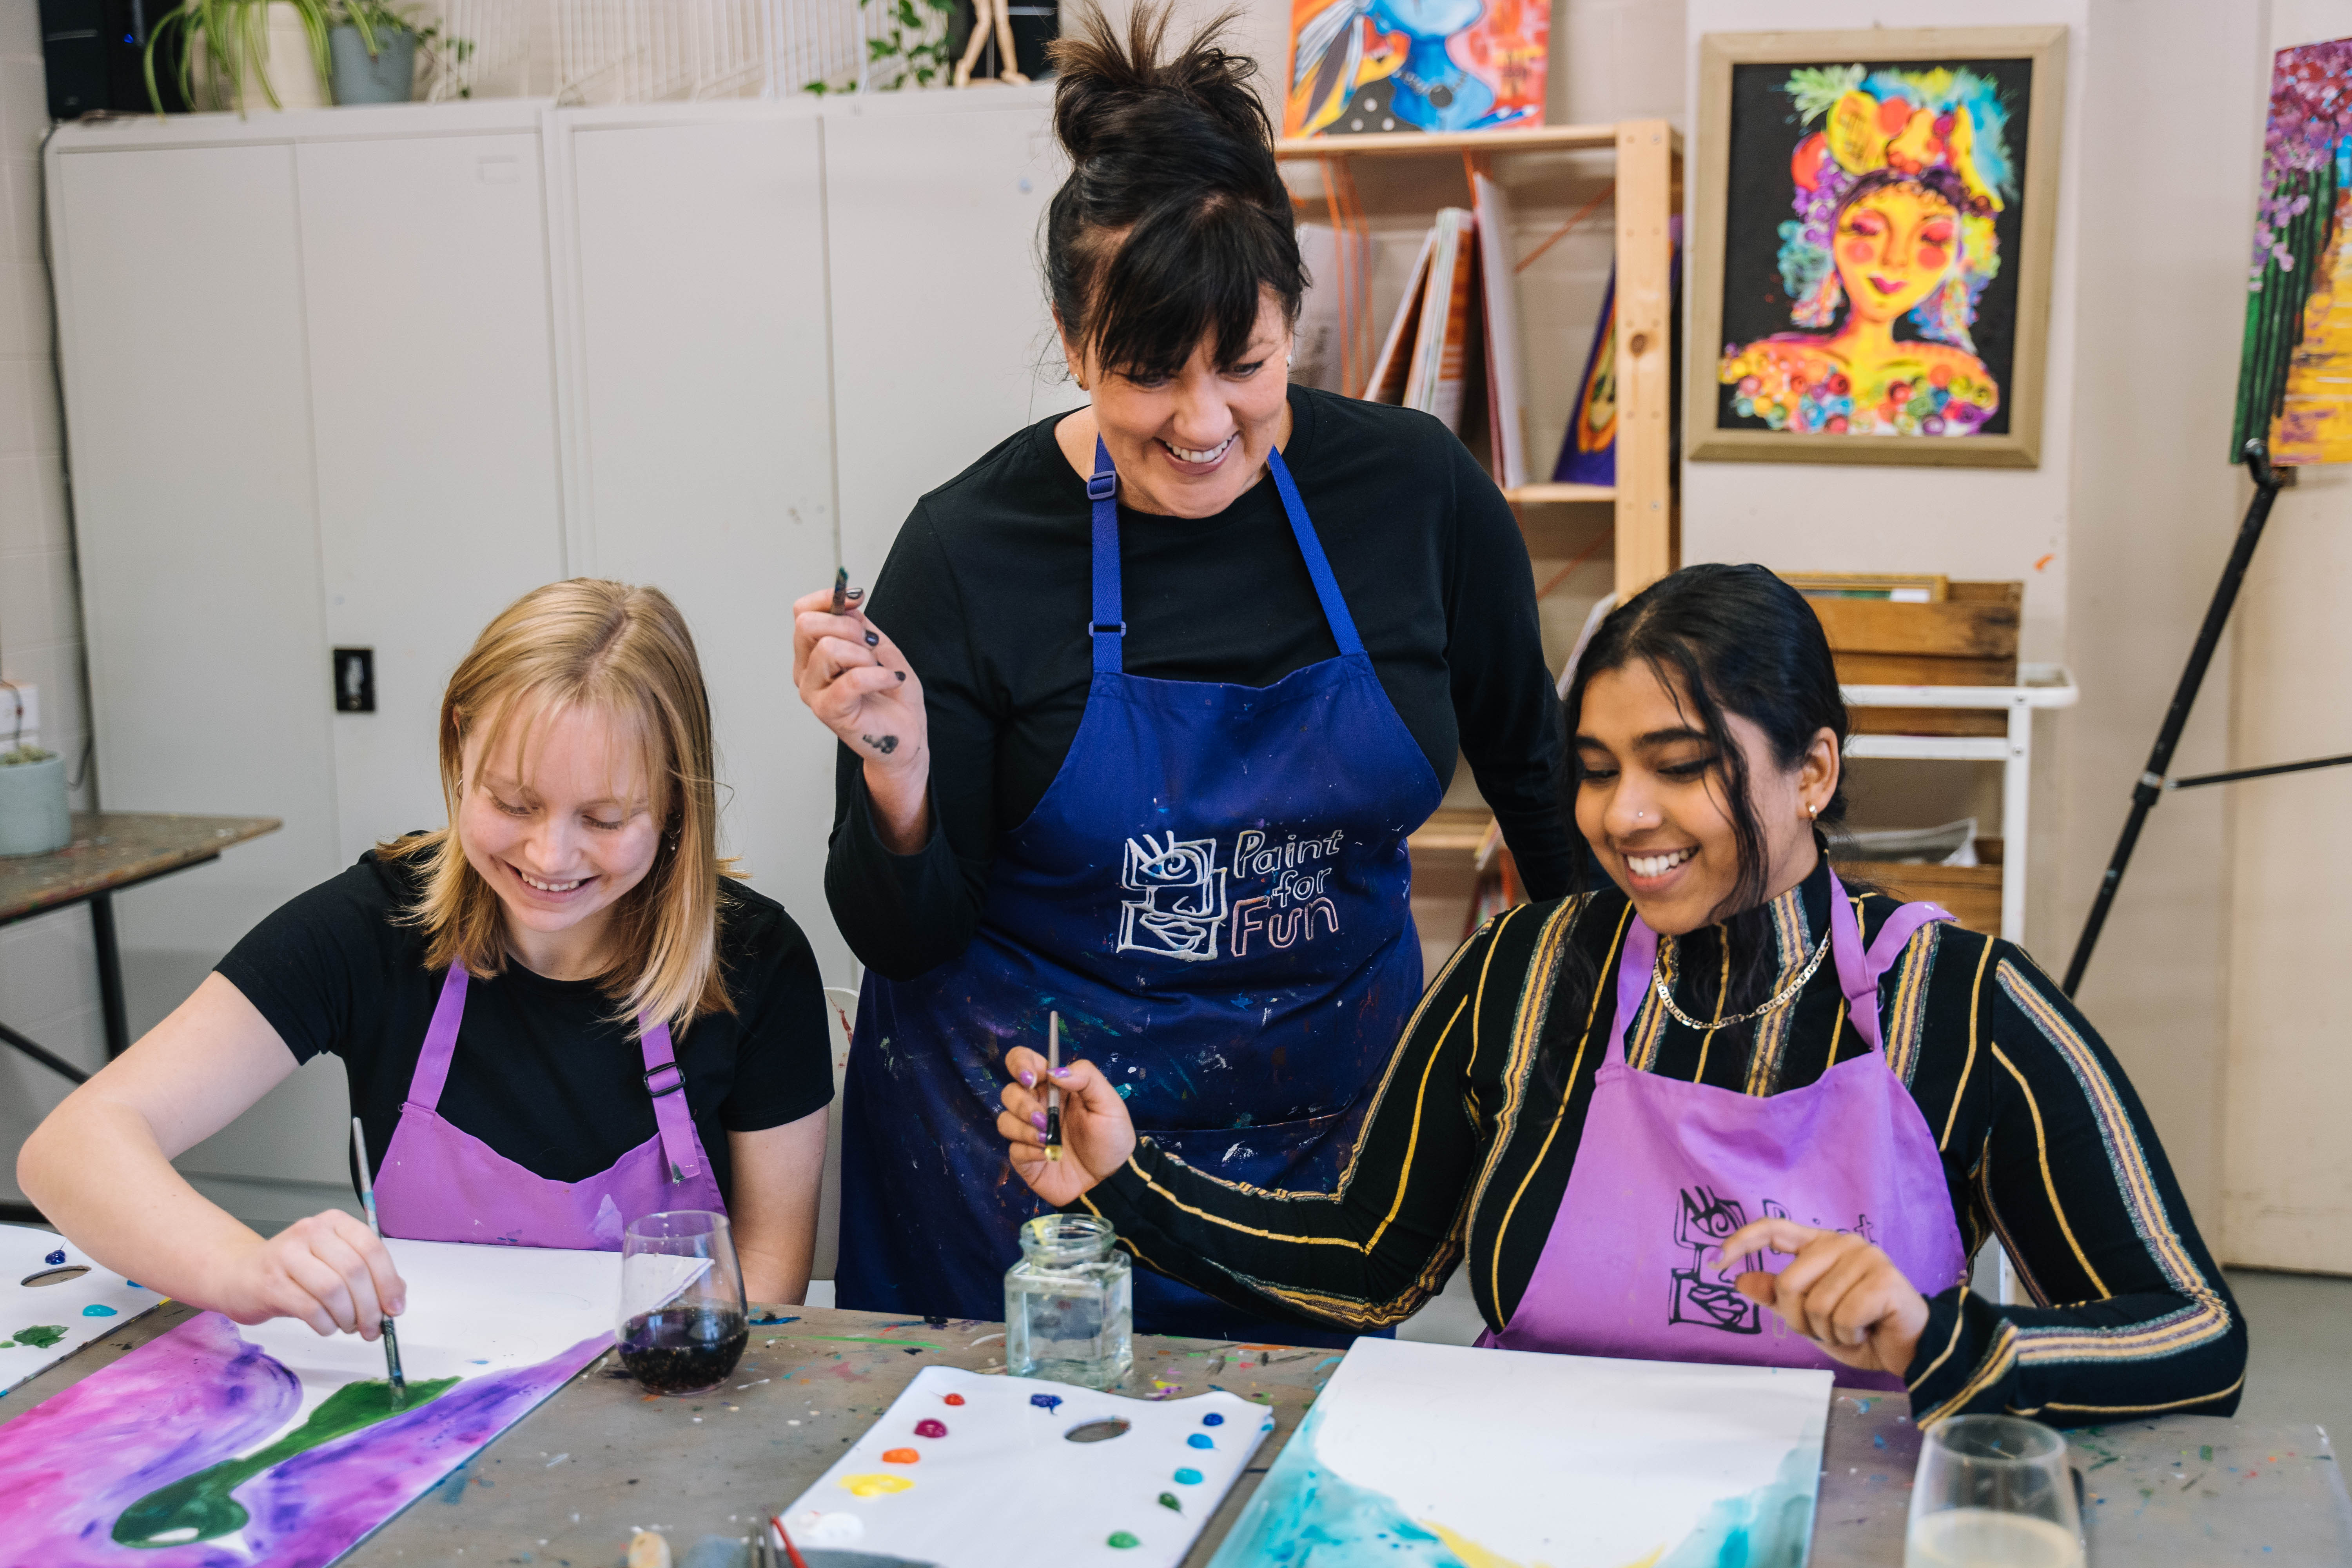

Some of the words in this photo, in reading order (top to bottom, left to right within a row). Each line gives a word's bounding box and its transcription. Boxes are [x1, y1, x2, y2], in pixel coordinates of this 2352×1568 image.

[1234, 830, 1344, 878] Paint
[1273, 867, 1332, 907] for
[1231, 896, 1339, 957] Fun
